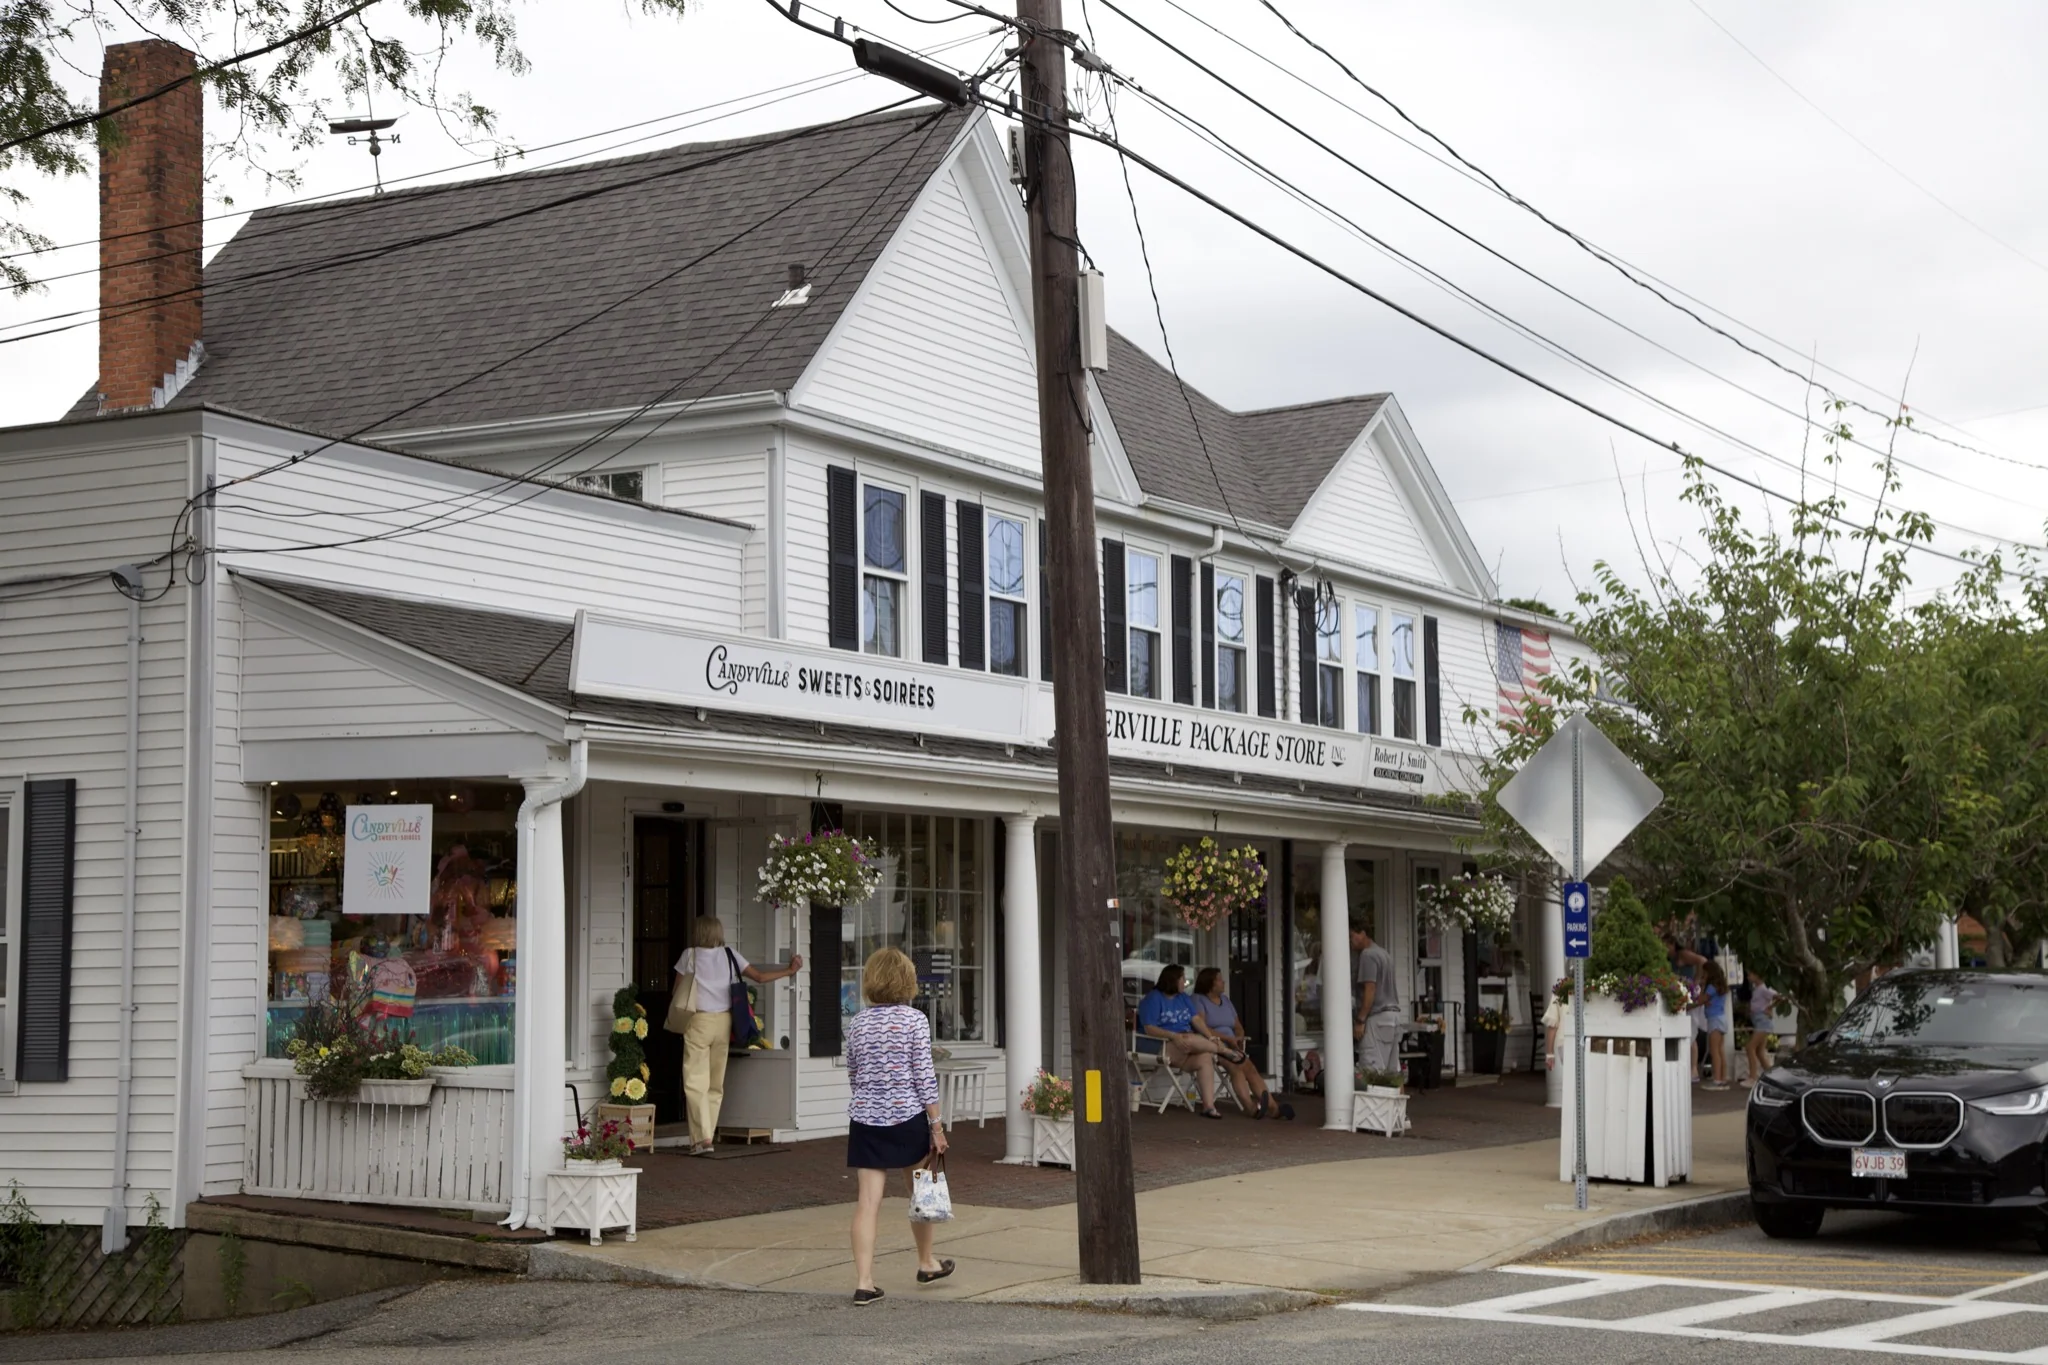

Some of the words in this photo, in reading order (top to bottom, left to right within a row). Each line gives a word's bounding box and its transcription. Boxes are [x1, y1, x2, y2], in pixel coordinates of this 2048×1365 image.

[798, 667, 862, 698] SWEETS
[865, 681, 872, 697] &
[873, 677, 935, 708] SOIRÉES
[1105, 708, 1183, 747] ERVILLE
[1190, 721, 1270, 759] PACKAGE
[1276, 734, 1326, 767] STORE
[1331, 745, 1347, 761] INC.
[1374, 747, 1398, 765] Robert
[1398, 751, 1405, 769] J.
[1407, 752, 1427, 769] Smith
[1566, 922, 1587, 932] PARKING
[1890, 1156, 1904, 1171] 39
